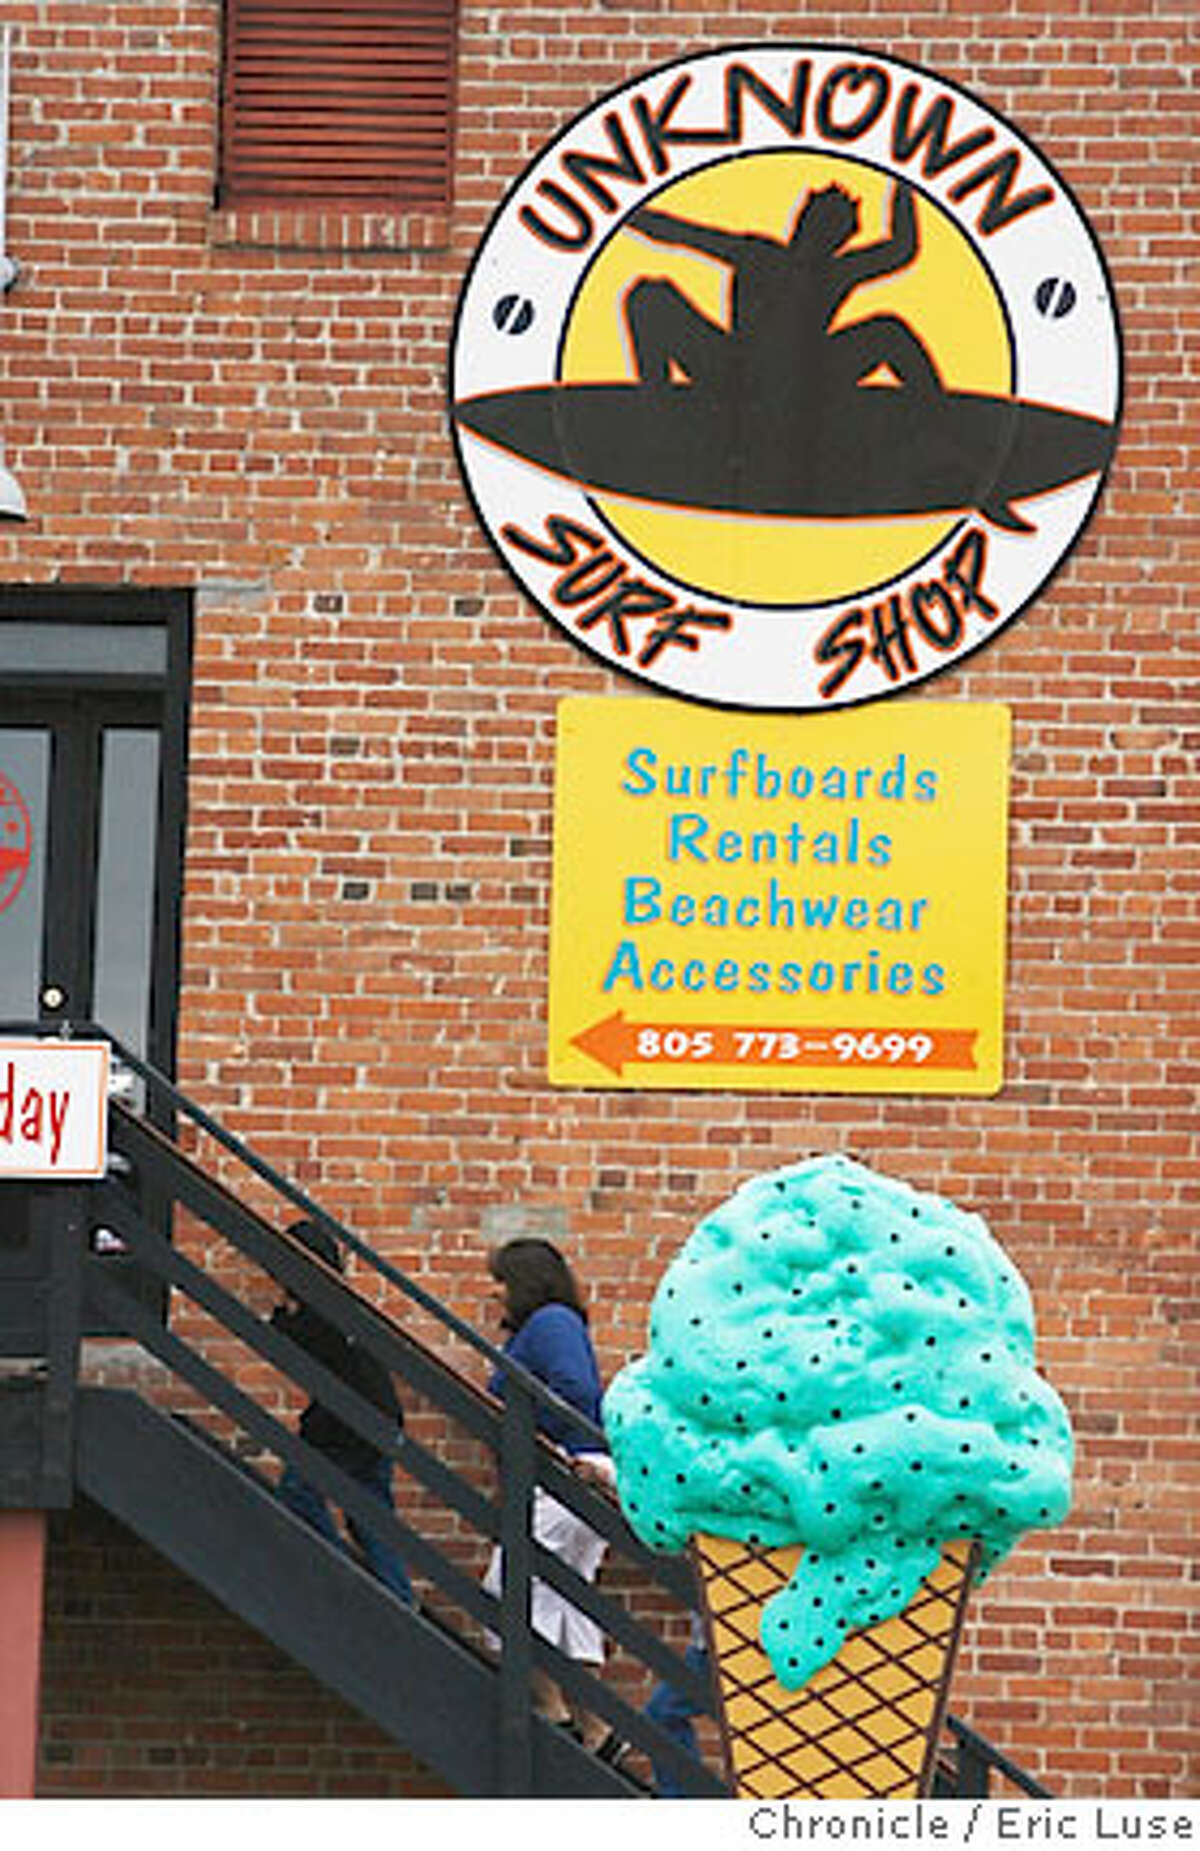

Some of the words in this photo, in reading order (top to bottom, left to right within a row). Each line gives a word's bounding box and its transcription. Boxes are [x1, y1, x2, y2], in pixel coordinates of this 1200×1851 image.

[519, 58, 1055, 253] UNKNOWN
[501, 513, 734, 668] SURF
[815, 526, 1000, 700] SHOP
[621, 748, 939, 802] Surfboards
[667, 813, 893, 866] Rentals
[623, 876, 929, 931] Beachwear
[602, 941, 946, 996] Accessories
[637, 1030, 714, 1058] 805
